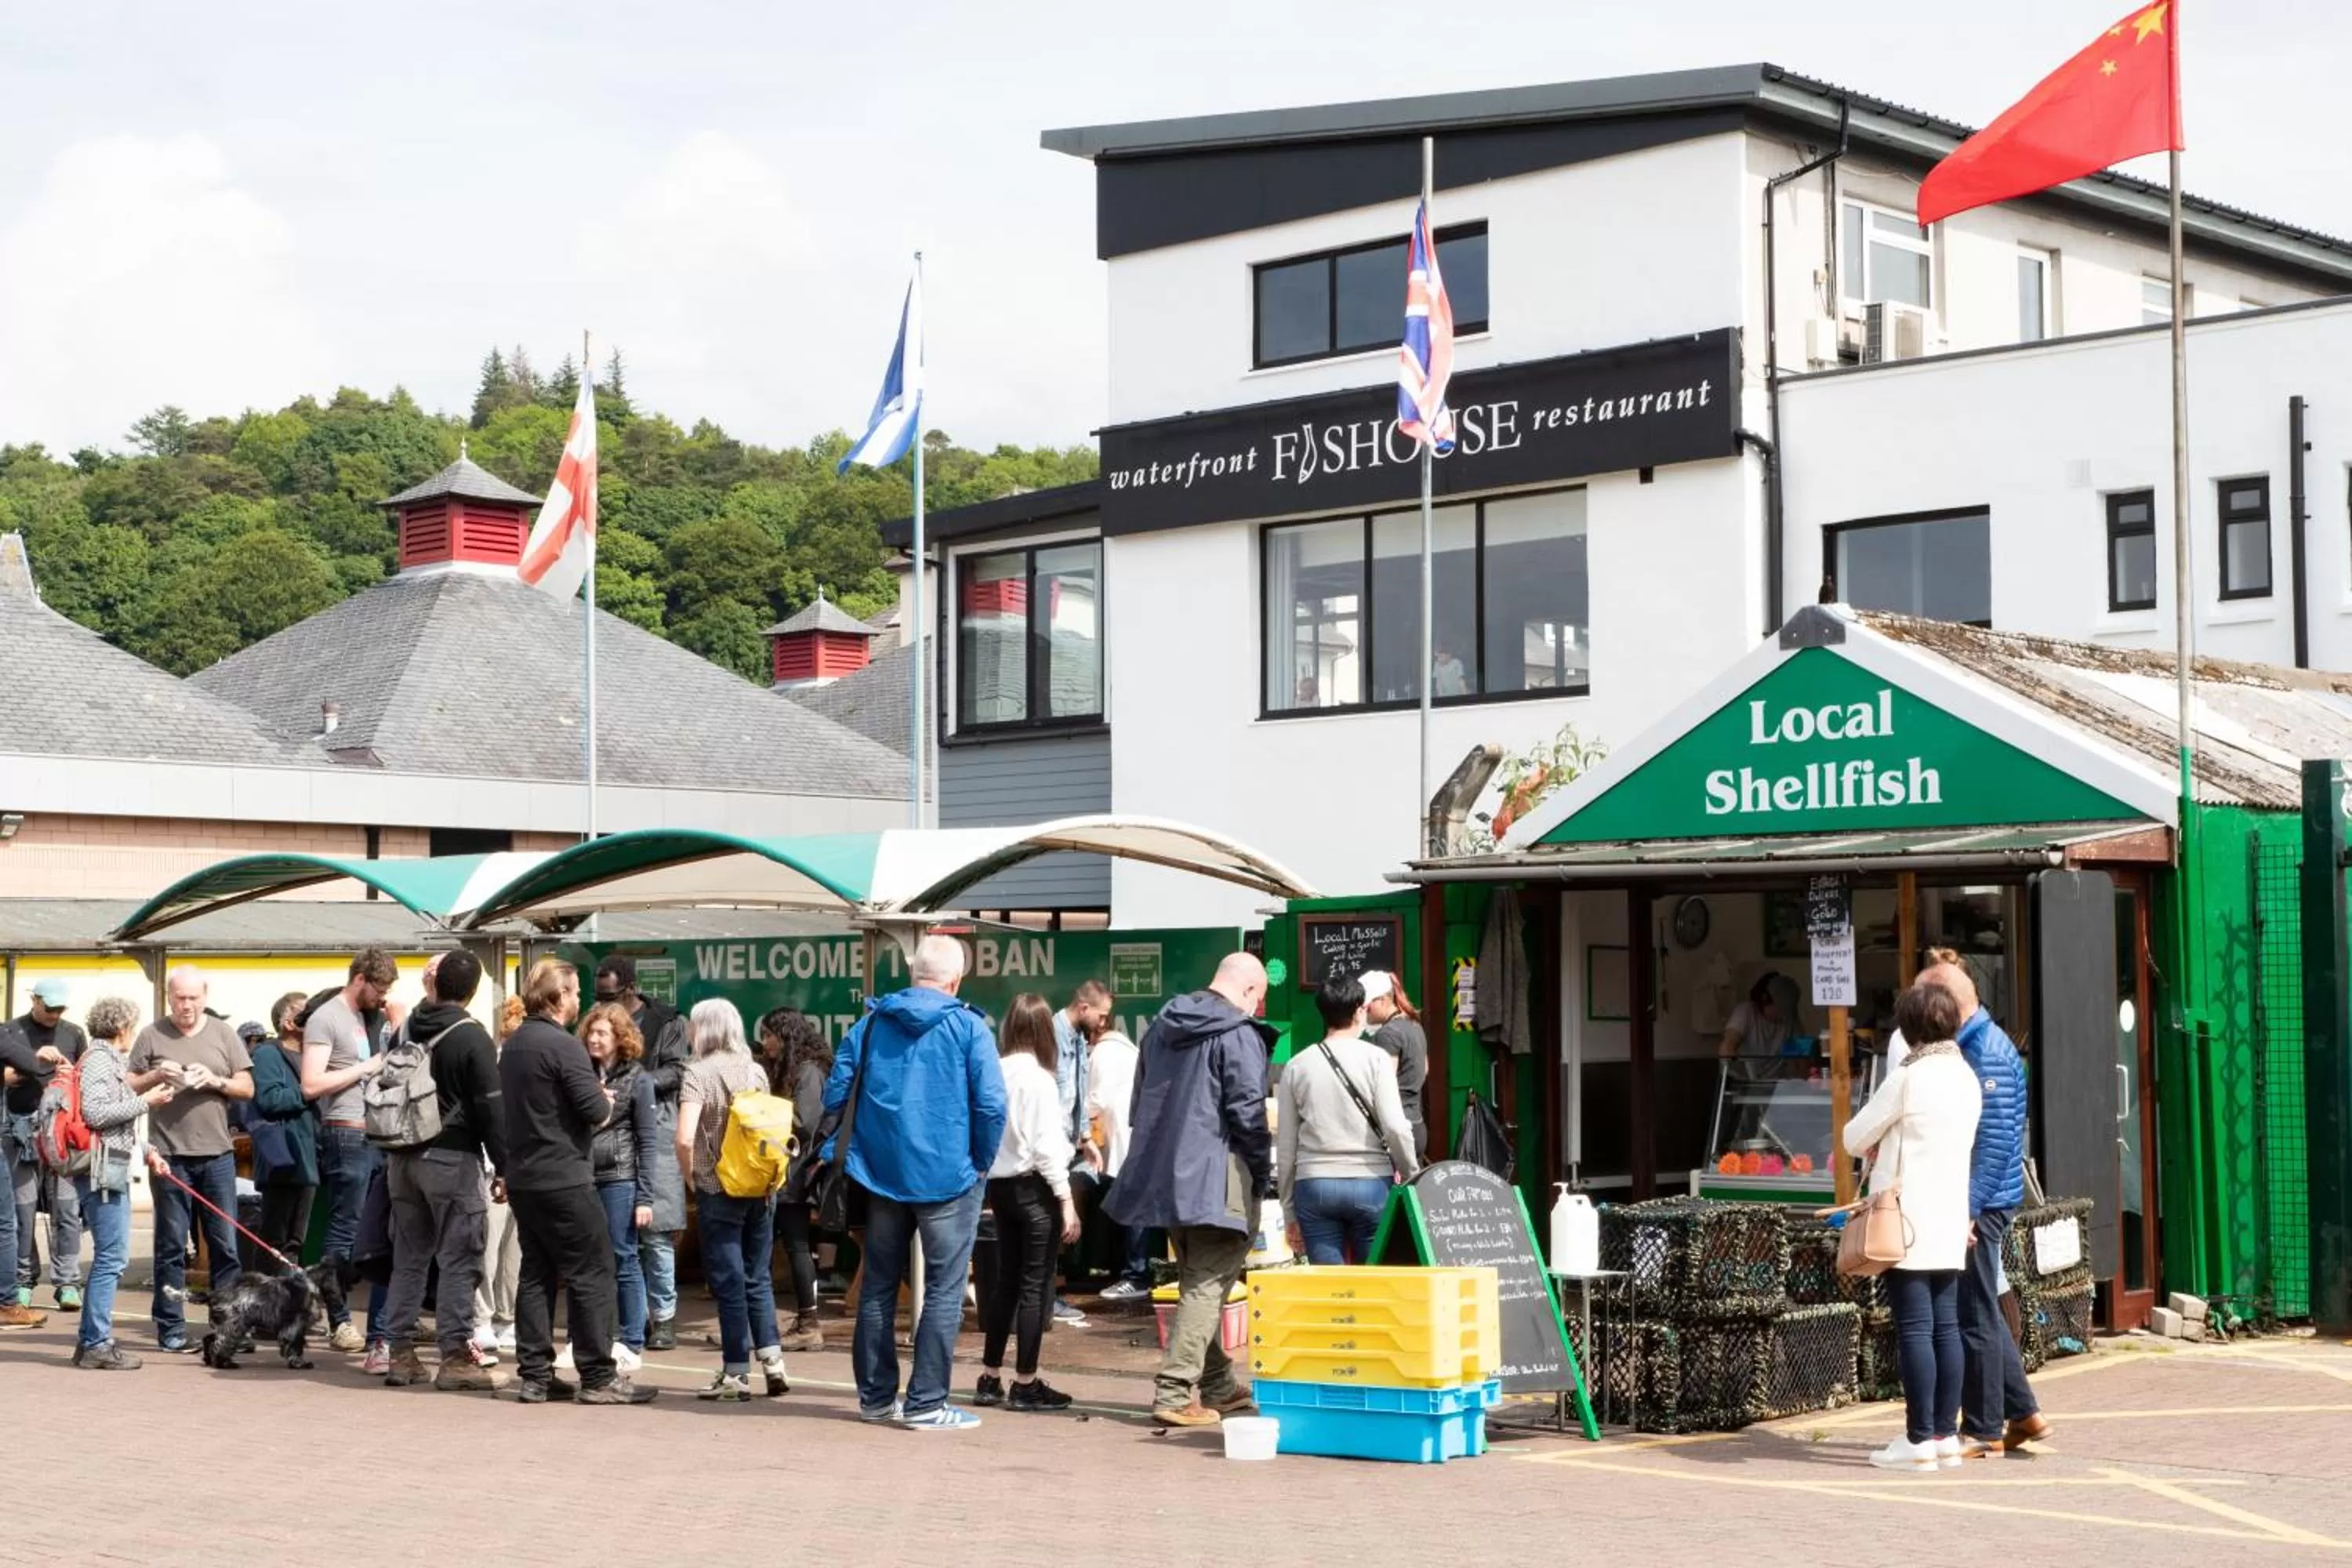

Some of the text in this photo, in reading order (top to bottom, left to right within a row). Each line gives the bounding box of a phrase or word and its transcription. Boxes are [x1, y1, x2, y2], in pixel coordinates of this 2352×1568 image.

[1109, 447, 1258, 490] waterfront
[1533, 379, 1711, 430] restaurant
[1749, 688, 1894, 744] Local
[1705, 757, 1942, 815] Shellfish
[695, 942, 865, 980] WELCOME
